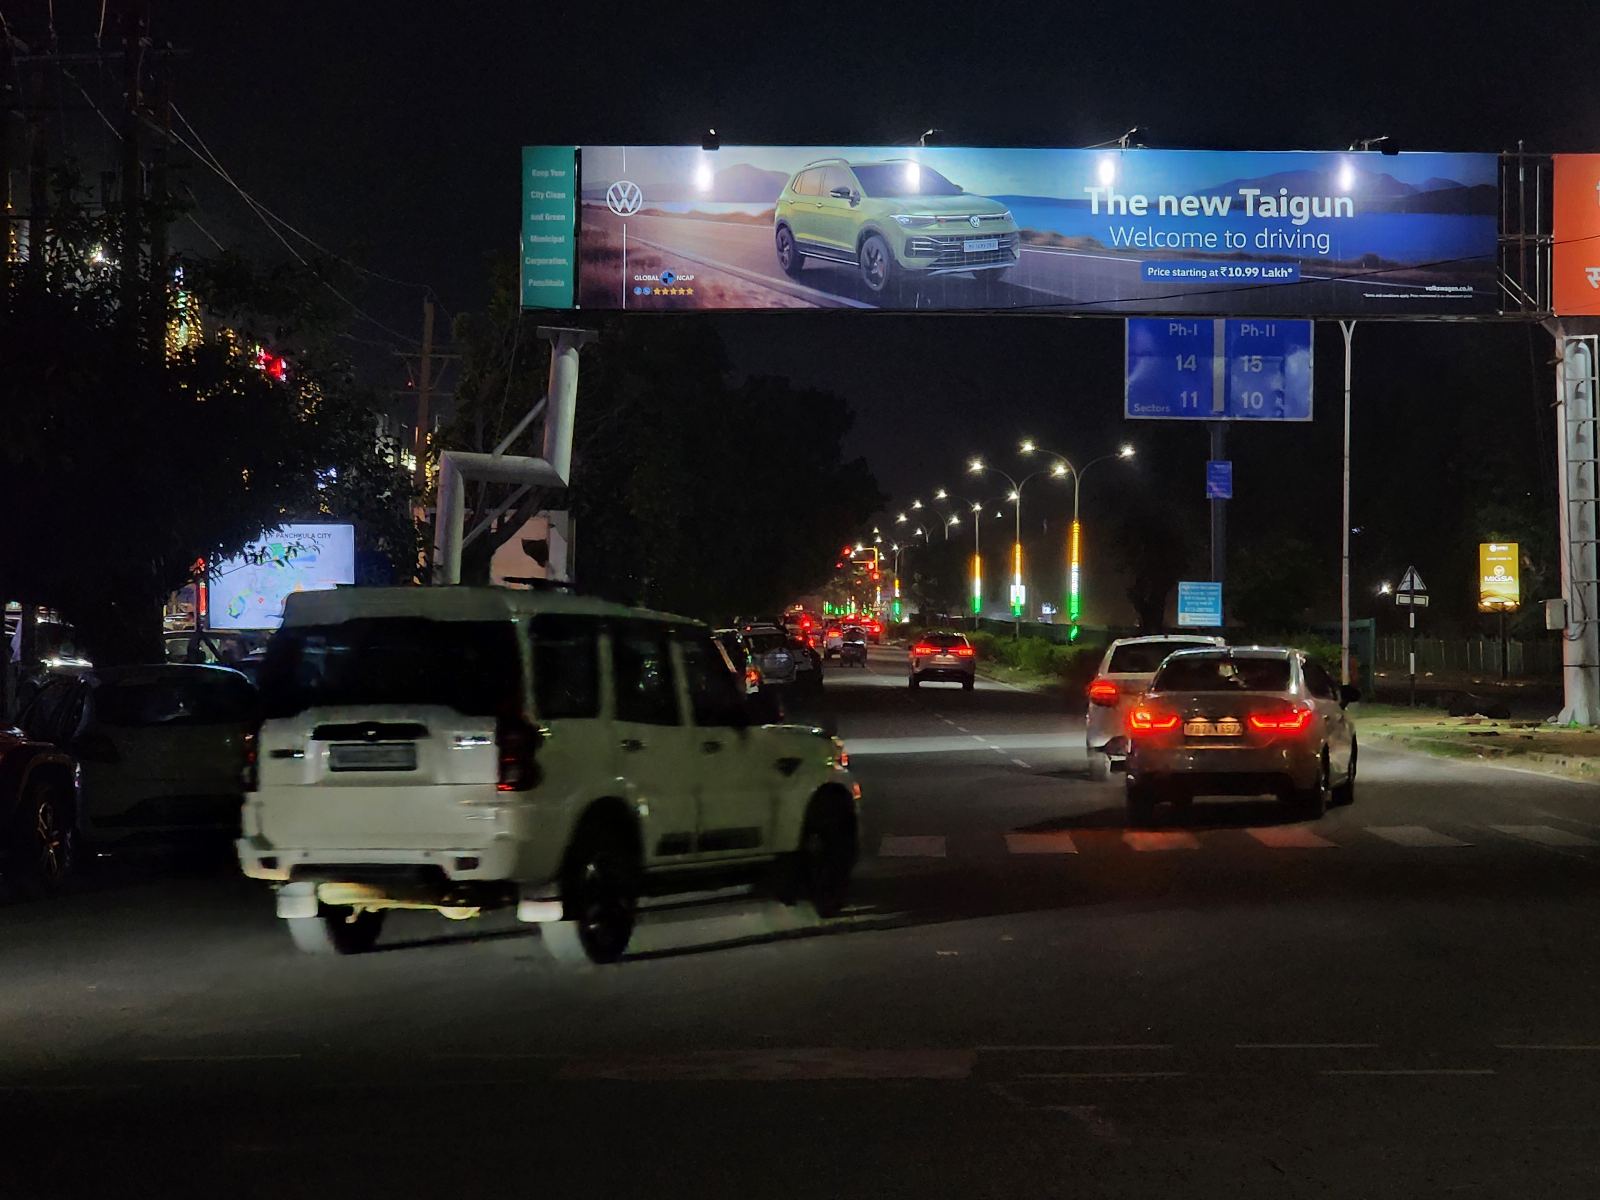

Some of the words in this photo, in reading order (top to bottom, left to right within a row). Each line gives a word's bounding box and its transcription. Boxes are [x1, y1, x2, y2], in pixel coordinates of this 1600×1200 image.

[530, 191, 544, 200] City
[545, 191, 566, 199] Clean
[1084, 186, 1148, 217] The
[1158, 195, 1231, 217] new
[1238, 188, 1355, 226] Taigun
[530, 213, 544, 221] and
[545, 213, 566, 221] Green
[530, 235, 565, 243] Municipal
[1109, 225, 1218, 249] Welcome
[1224, 229, 1247, 249] to
[1254, 228, 1331, 255] driving
[1147, 266, 1171, 278] Price
[1172, 266, 1208, 280] starting
[1208, 268, 1219, 278] at
[1220, 266, 1259, 278] ₹10.99
[1169, 323, 1198, 336] Ph-I
[1241, 324, 1275, 336] Ph-II
[1176, 354, 1196, 372] 14
[1241, 355, 1263, 373] 15
[1180, 391, 1198, 408] 11
[1241, 391, 1263, 409] 10
[1133, 403, 1170, 413] Sectors
